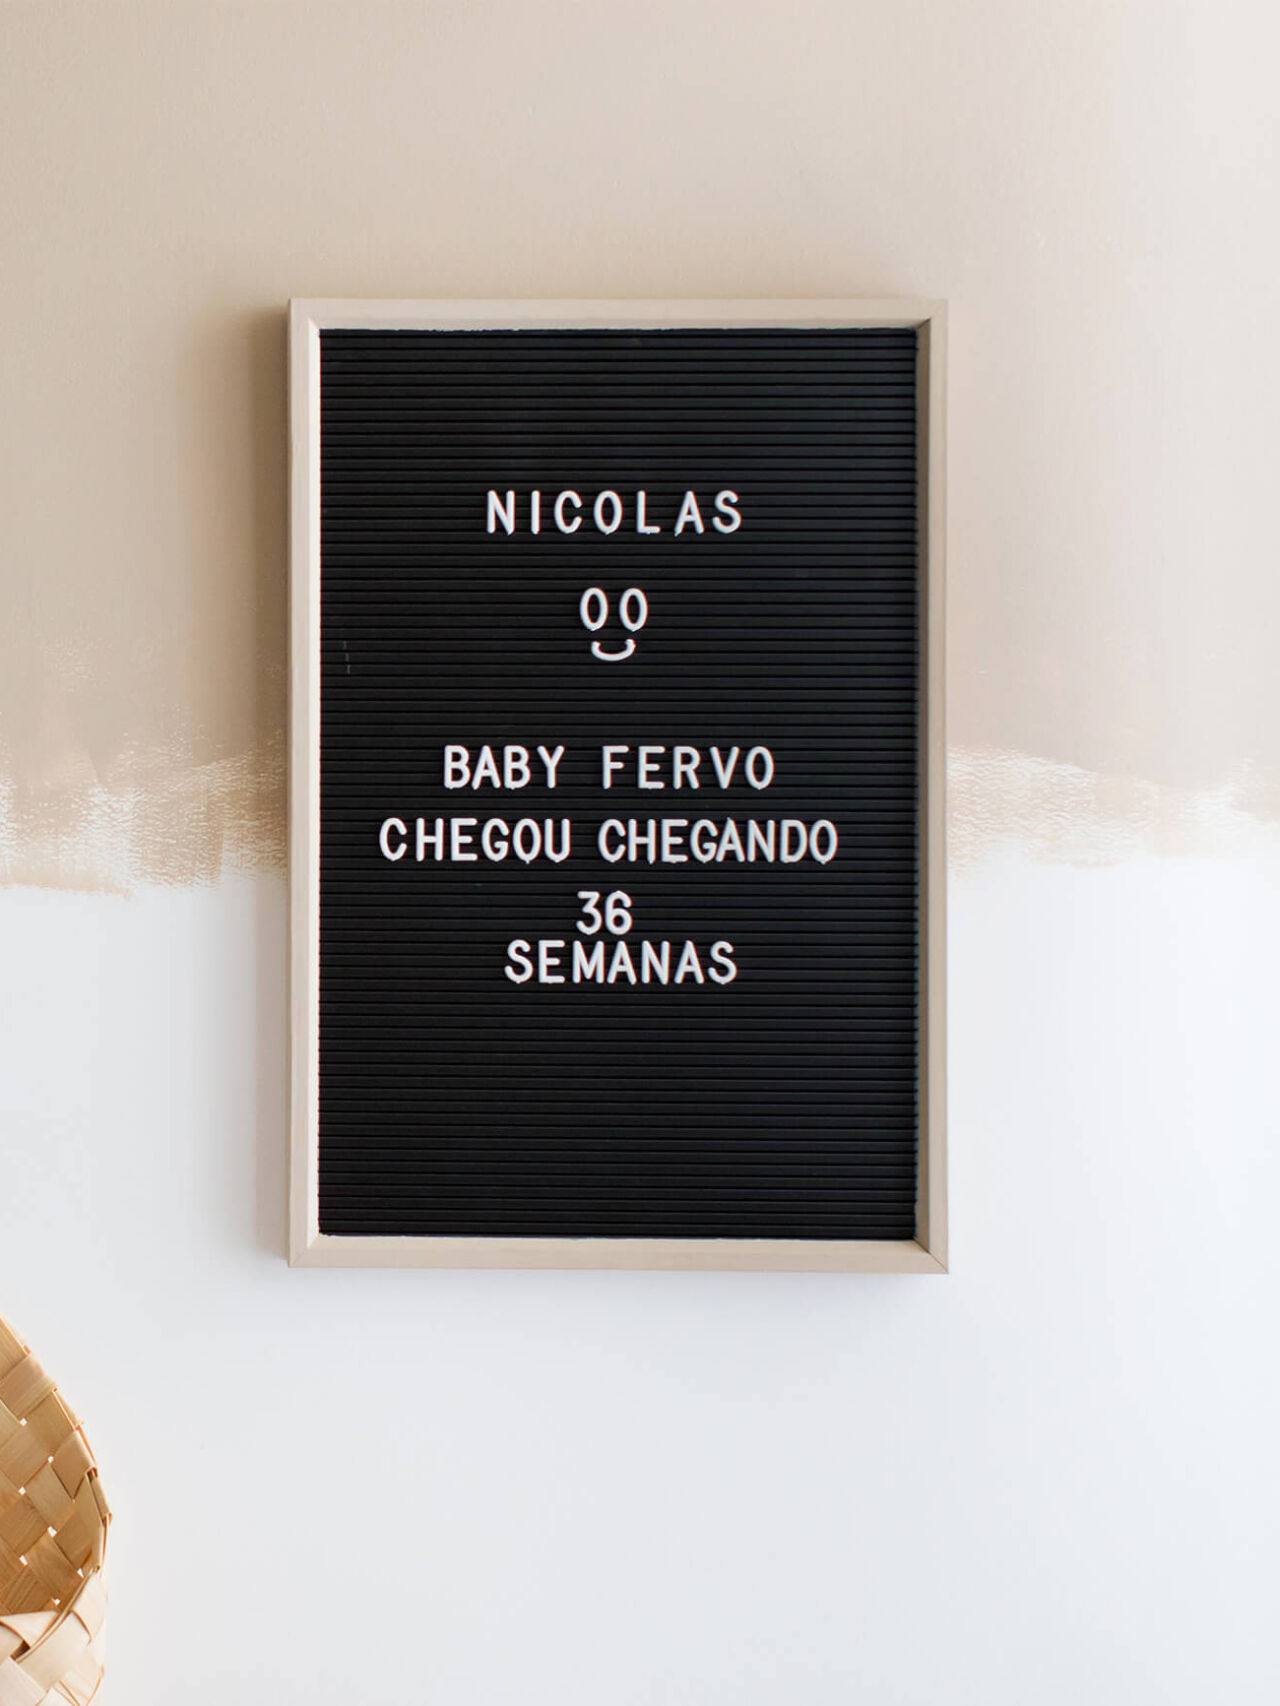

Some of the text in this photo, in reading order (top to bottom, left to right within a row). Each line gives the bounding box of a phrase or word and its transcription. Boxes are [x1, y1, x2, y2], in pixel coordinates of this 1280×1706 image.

[486, 489, 743, 536] NICOLAS
[444, 744, 776, 791] BABY FERVO
[378, 816, 839, 865] CHEGOU CHEGANDO
[576, 889, 634, 936] 36
[503, 939, 739, 986] SEMANAS
